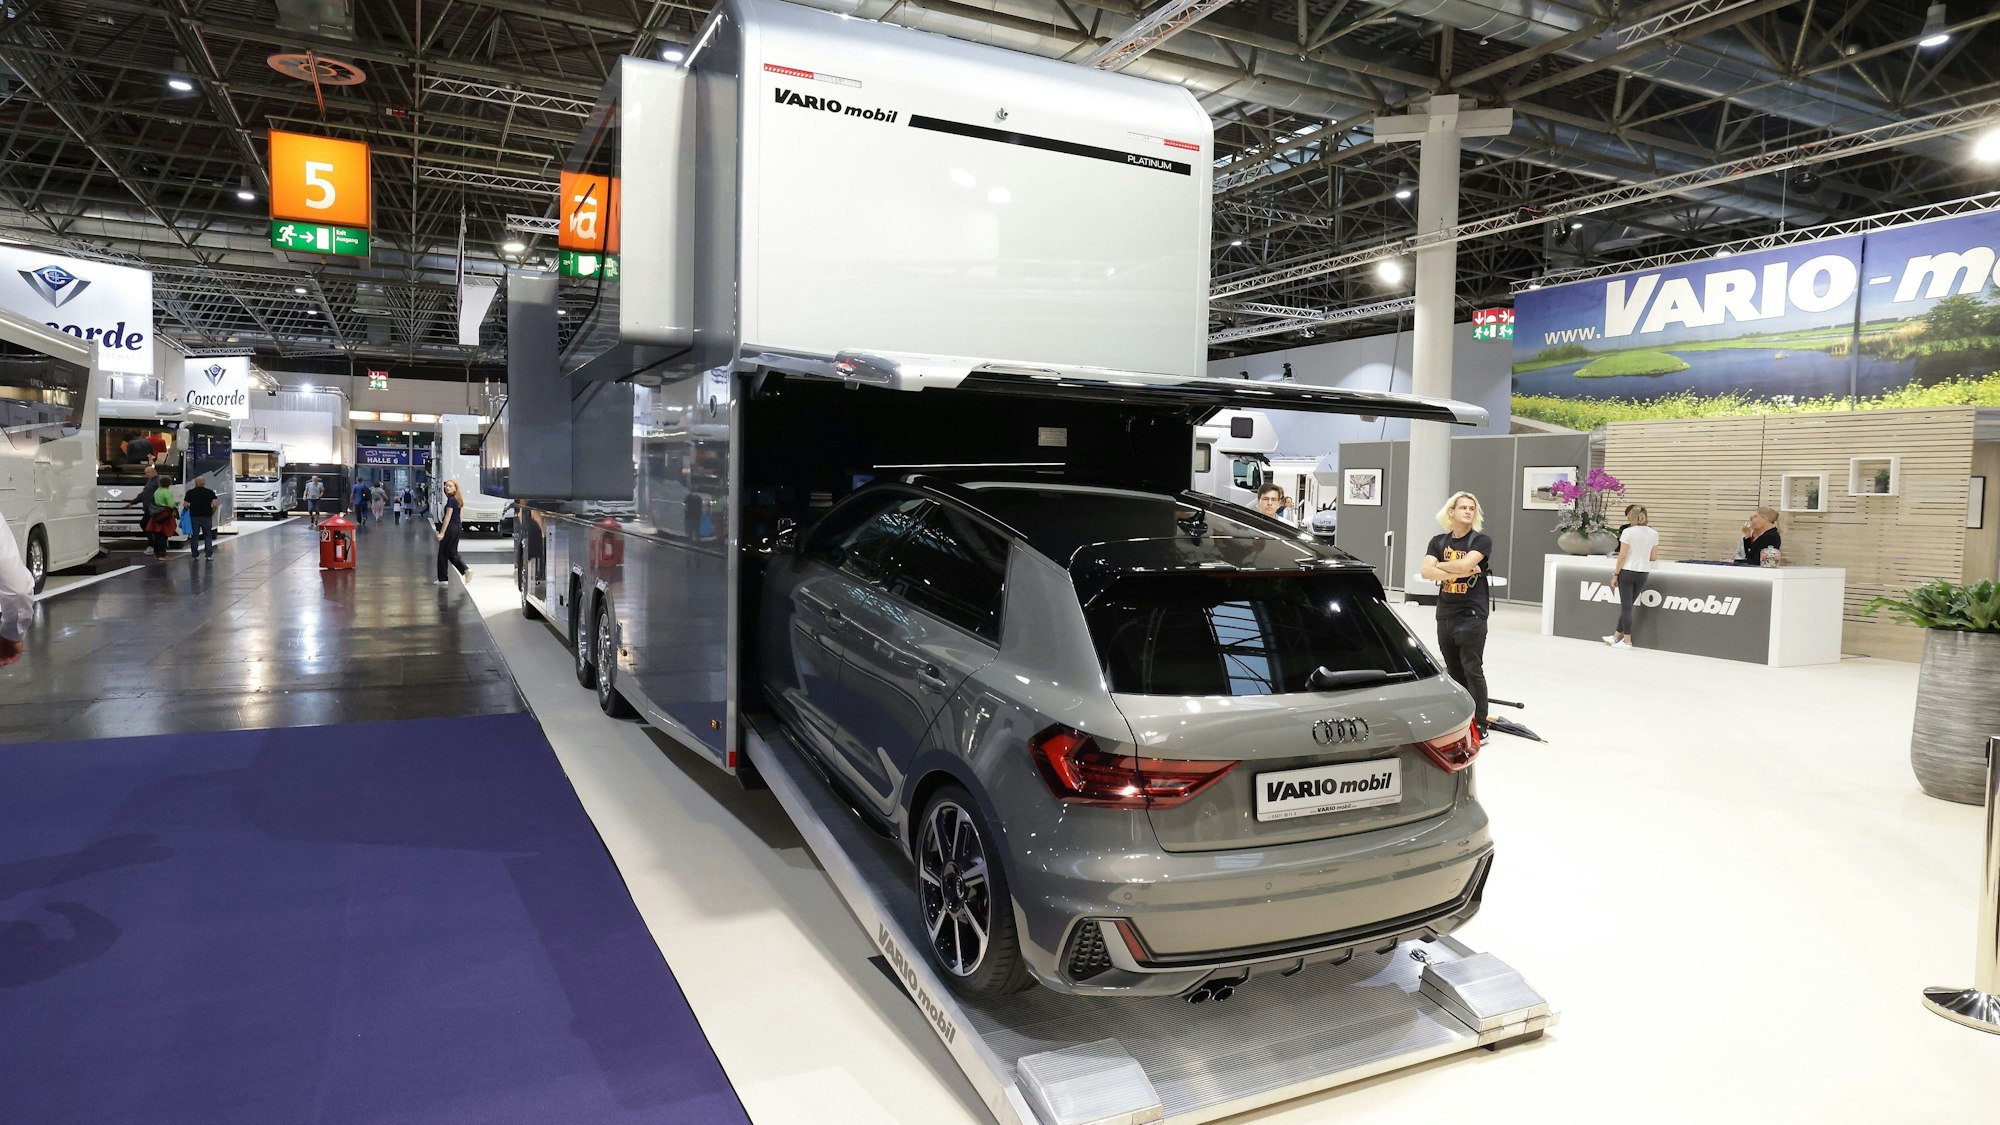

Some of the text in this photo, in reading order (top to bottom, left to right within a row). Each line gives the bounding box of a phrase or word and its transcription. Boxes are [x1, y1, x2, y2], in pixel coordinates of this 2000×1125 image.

[774, 87, 898, 124] VARIO mobil
[1127, 154, 1172, 170] PLATINUM
[305, 160, 336, 210] 5
[335, 236, 359, 244] Ausgang
[1544, 246, 2000, 346] www.VARIO-m
[186, 389, 245, 406] Concorde
[1662, 594, 1742, 616] mobil
[1267, 772, 1392, 802] VARIO mobil
[1317, 805, 1336, 813] VARIO
[878, 921, 957, 1045] VARIO mobil
